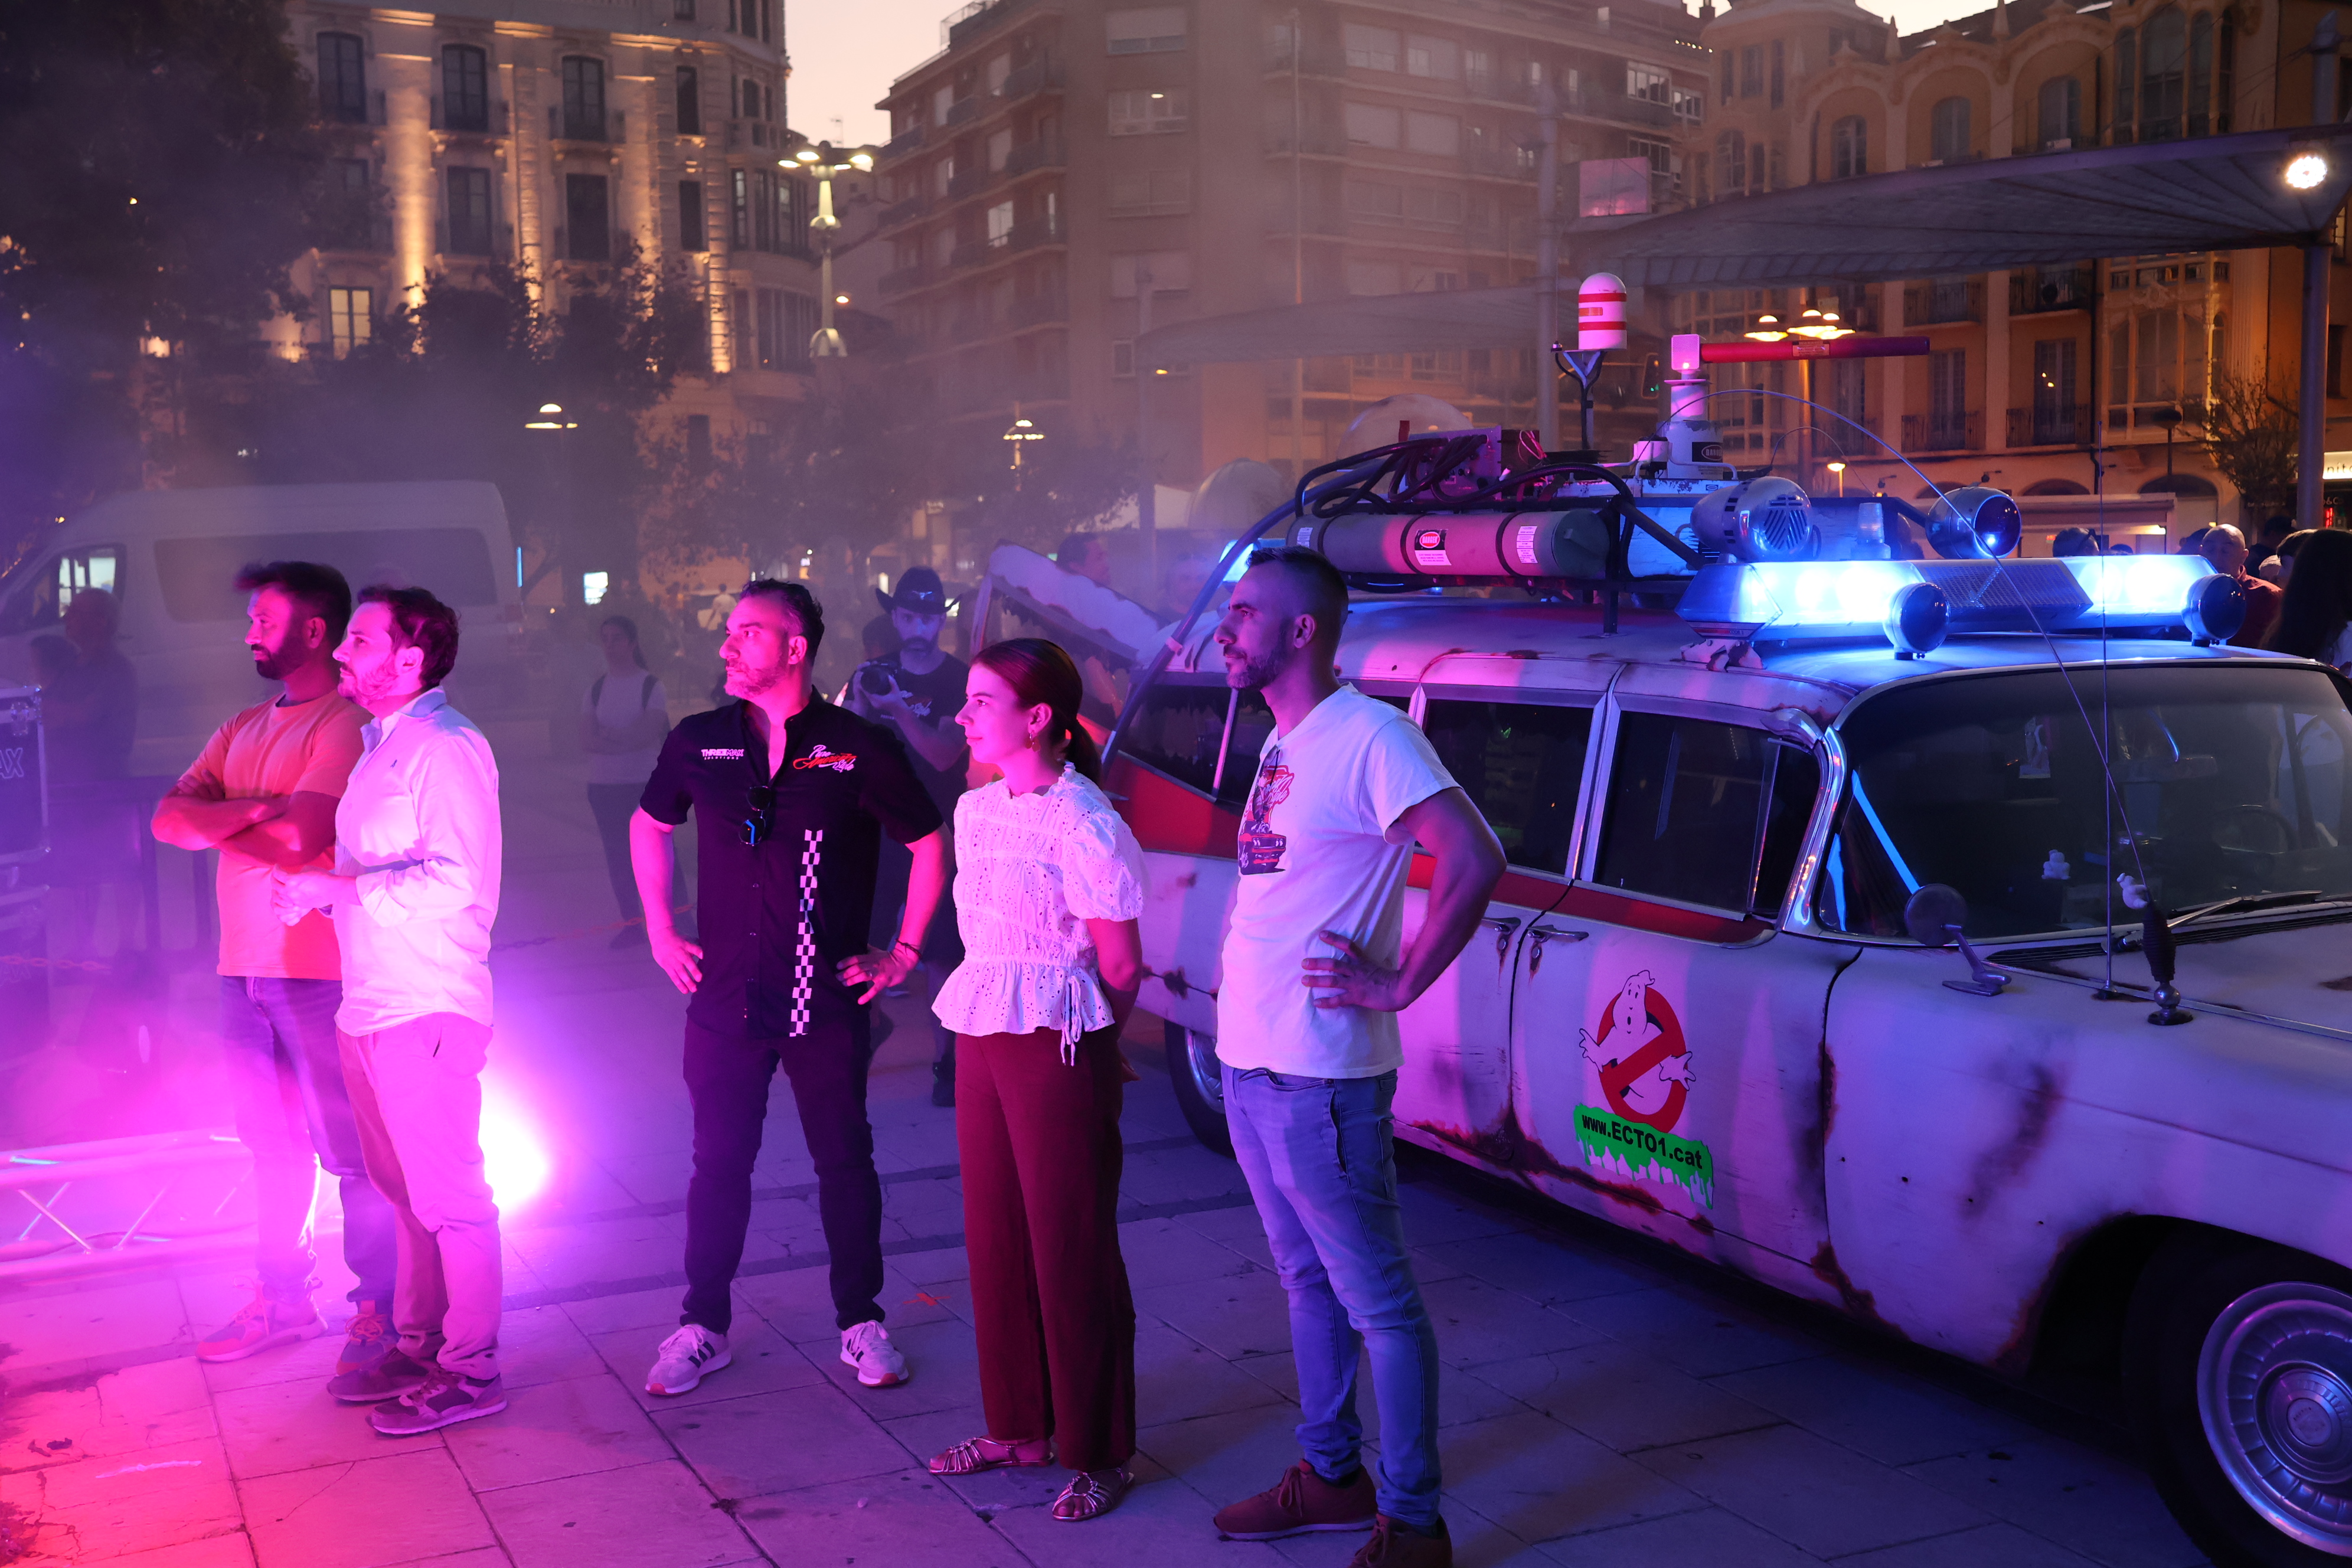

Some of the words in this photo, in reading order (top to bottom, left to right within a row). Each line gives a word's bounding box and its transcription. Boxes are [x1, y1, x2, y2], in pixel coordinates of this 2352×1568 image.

[1422, 535, 1438, 544] DANGER
[809, 744, 835, 759] Pure
[793, 753, 857, 769] American
[825, 758, 856, 773] Style
[1582, 1115, 1703, 1169] www.ECTO1.cat
